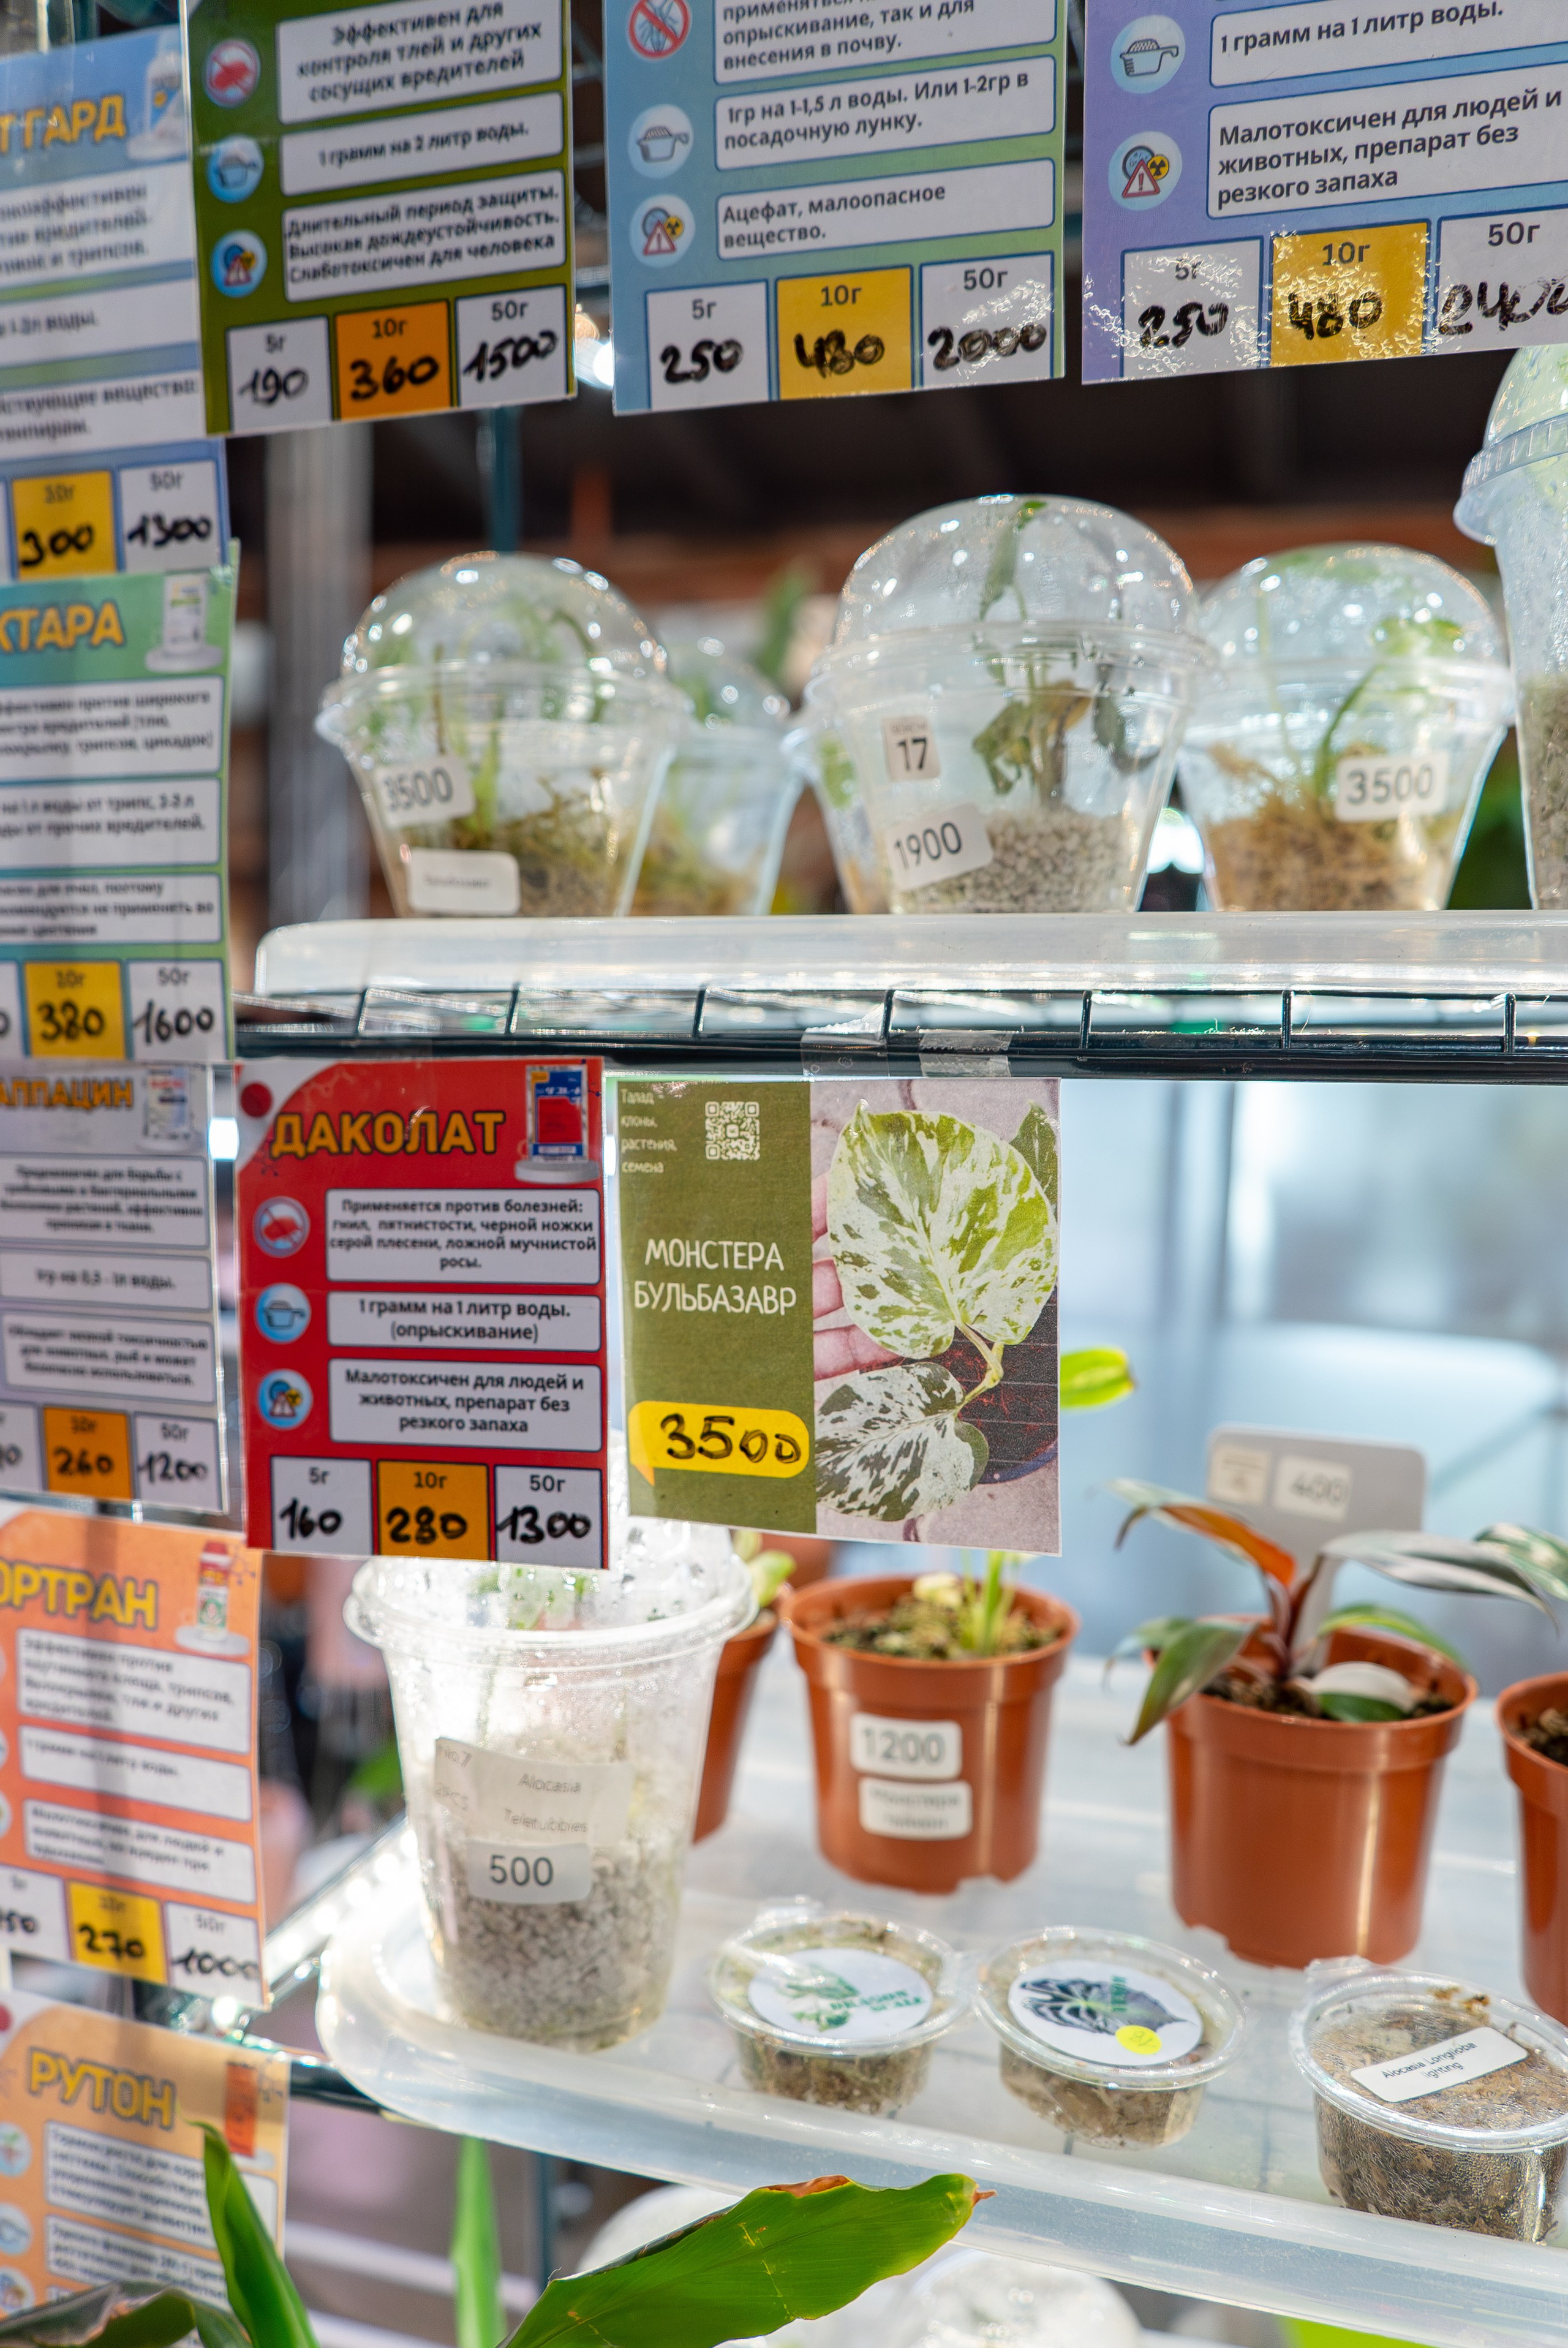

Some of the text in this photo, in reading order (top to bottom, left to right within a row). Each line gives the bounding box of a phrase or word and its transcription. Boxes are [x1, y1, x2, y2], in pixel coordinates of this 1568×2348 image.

[331, 2, 503, 48] Эффективен для
[723, 0, 974, 47] опрыскивание, так и для
[1220, 1, 1503, 56] 1 грамм на 1 литр воды.
[297, 22, 541, 78] контроля тлей и других
[723, 34, 902, 70] внесения в почву.
[309, 48, 525, 104] сосущих вредителей
[728, 71, 1028, 125] 1гр на 1-1,5 л воды. Или 1-2гр в
[725, 112, 922, 151] посадочную лунку.
[1219, 88, 1561, 146] Малотоксичен для людей и
[319, 122, 529, 169] 1 грамм на 2 литр воды.
[1218, 124, 1519, 176] животных, препарат без
[723, 184, 946, 226] Ацефат, малоопасное
[1218, 171, 1398, 210] резкого запаха
[285, 186, 557, 238] Длительный период защиты.
[723, 225, 826, 252] вещество.
[1488, 222, 1540, 246] 50г
[290, 234, 555, 284] Слаботоксичен для человека
[1174, 259, 1201, 279] 5г
[1322, 241, 1371, 267] 10г
[820, 284, 861, 307] 10г
[963, 267, 1008, 291] 50г
[372, 319, 408, 338] 10г
[491, 299, 528, 321] 50г
[692, 300, 716, 320] 5г
[1139, 301, 1229, 349] 250
[1289, 289, 1383, 341] 480
[464, 329, 559, 382] 1500
[661, 338, 742, 384] 250
[794, 330, 886, 379] 480
[929, 323, 1047, 371] 2000
[239, 367, 307, 404] 190
[350, 355, 440, 401] 360
[20, 525, 94, 568] 300
[127, 513, 211, 547] 1300
[897, 738, 927, 771] 17
[1347, 764, 1433, 805] 3500
[894, 821, 962, 870] 1900
[132, 999, 214, 1046] 1600
[270, 1110, 505, 1159] ДАКОЛАТ
[342, 1199, 583, 1215] Применяется против болезней:
[330, 1234, 597, 1253] серой плесени, ложной мучнистой
[379, 1219, 477, 1234] пятнистости,
[480, 1218, 538, 1234] черной
[541, 1220, 593, 1233] ножки
[440, 1256, 481, 1270] росы.
[644, 1237, 784, 1272] МОНСТЕРА
[359, 1300, 570, 1319] 1 грамм на 1 литр воды.
[633, 1280, 796, 1316] БУЛЬБАЗАВР
[391, 1322, 538, 1343] (опрыскивание)
[345, 1369, 583, 1392] Малотоксичен для людей и
[359, 1394, 570, 1413] животных, препарат без
[399, 1416, 528, 1432] резкого запаха
[660, 1413, 801, 1465] 3500
[53, 1446, 113, 1477] 260
[137, 1451, 208, 1484] 1200
[309, 1468, 330, 1485] 5г
[413, 1471, 447, 1490] 10г
[530, 1474, 566, 1492] 50г
[279, 1498, 342, 1540] 160
[386, 1506, 468, 1545] 280
[496, 1506, 591, 1544] 1300
[864, 1728, 945, 1765] 1200
[491, 1855, 554, 1886] 500
[78, 1923, 146, 1959] 270
[172, 1946, 260, 1980] 1000
[29, 2046, 175, 2130] РУТОН
[1382, 2061, 1425, 2079] Alocasia
